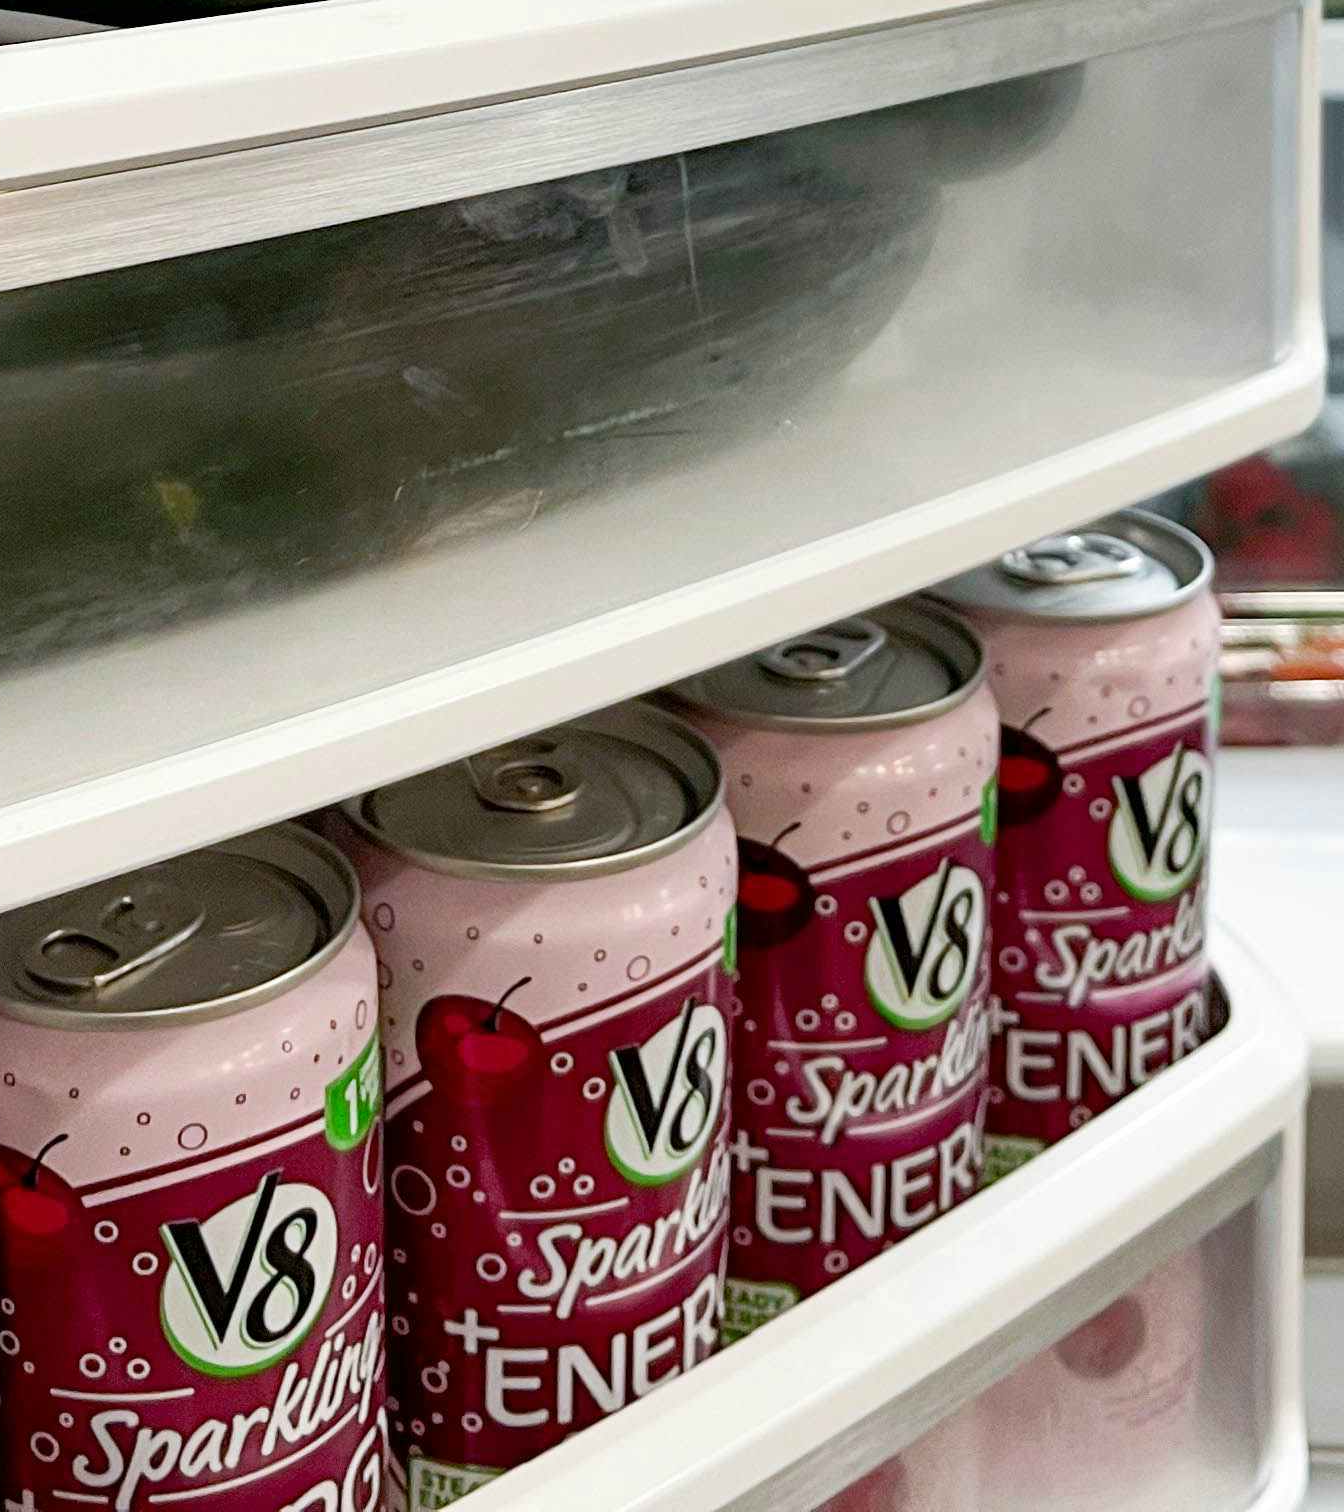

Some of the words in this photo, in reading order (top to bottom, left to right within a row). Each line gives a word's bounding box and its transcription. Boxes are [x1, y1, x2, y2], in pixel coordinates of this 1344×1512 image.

[1111, 740, 1203, 873] V8
[869, 856, 973, 1004] V8
[609, 996, 717, 1161] V8
[159, 1167, 319, 1351] V8
[72, 1310, 385, 1512] Sparkling
